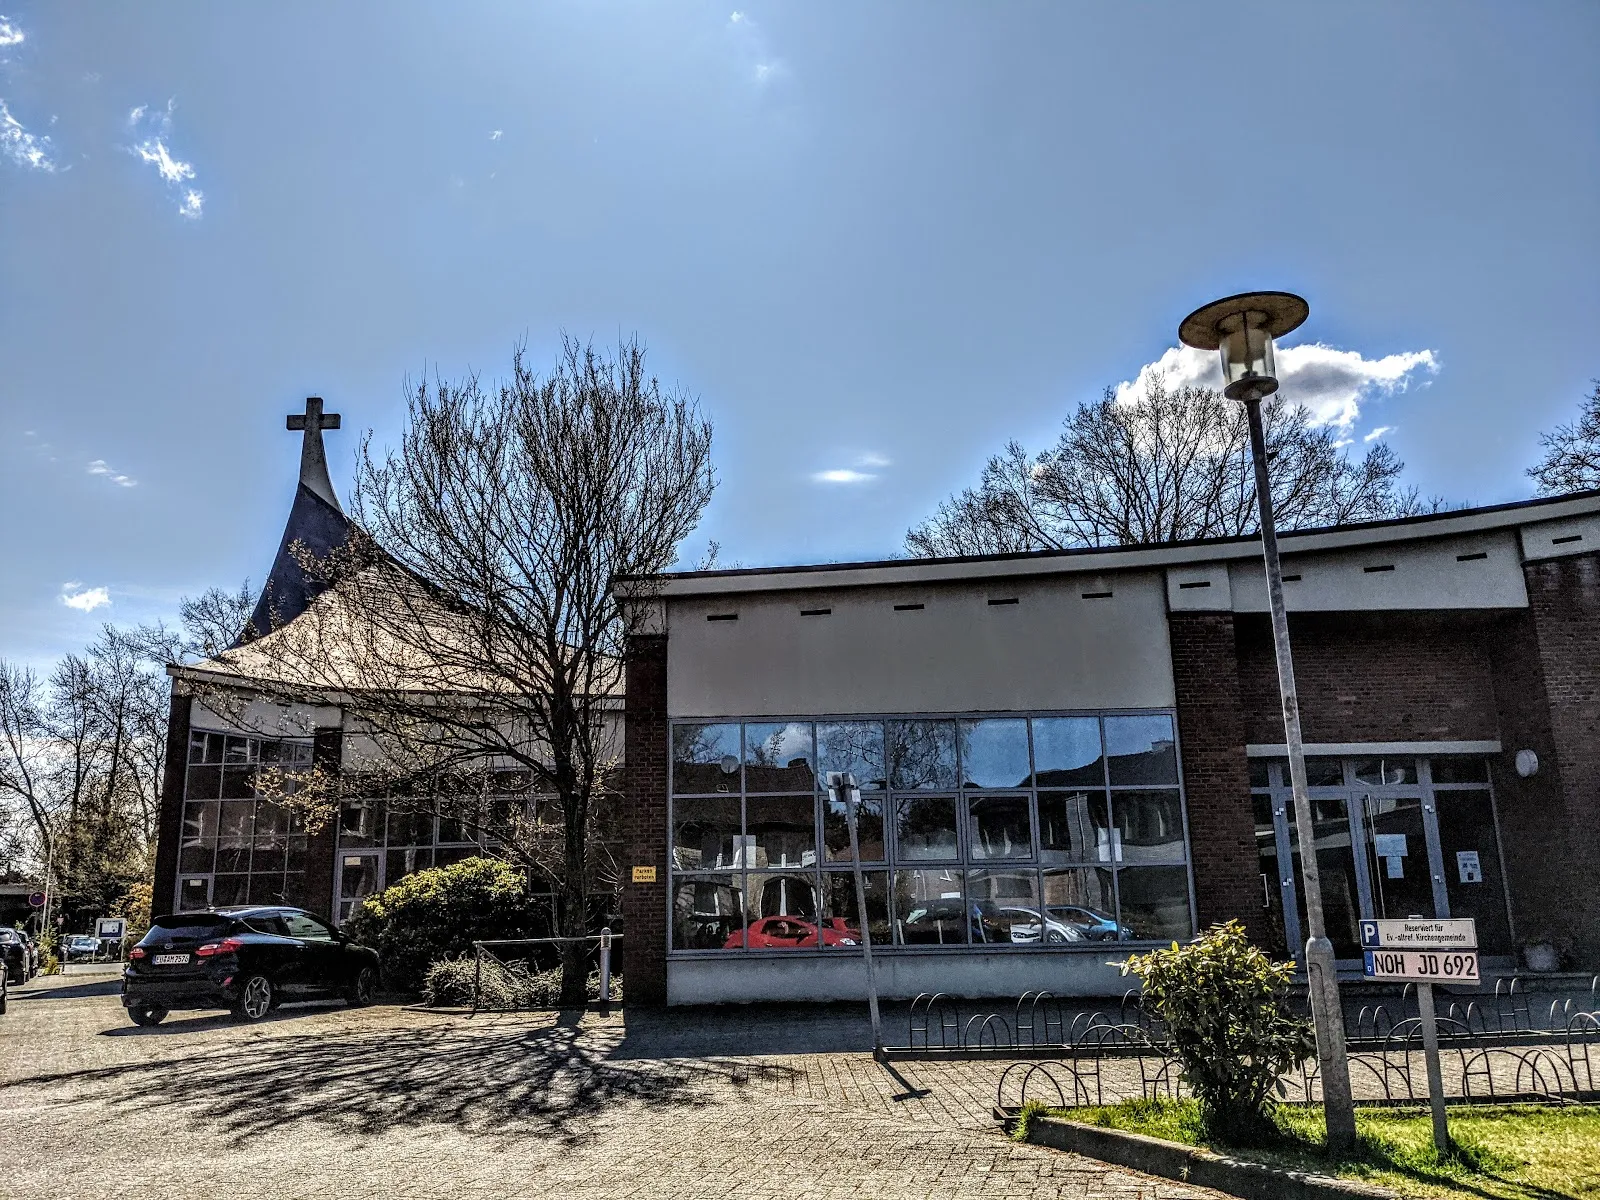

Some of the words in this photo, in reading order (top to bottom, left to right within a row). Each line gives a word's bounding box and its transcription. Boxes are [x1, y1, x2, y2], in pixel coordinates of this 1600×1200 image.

[1364, 924, 1375, 943] P
[1404, 924, 1433, 932] Reserviert
[1434, 924, 1443, 932] für
[1416, 933, 1466, 943] Kirchengemeinde
[1374, 954, 1405, 974] NOH
[1418, 955, 1439, 974] JD
[1443, 955, 1476, 976] 692
